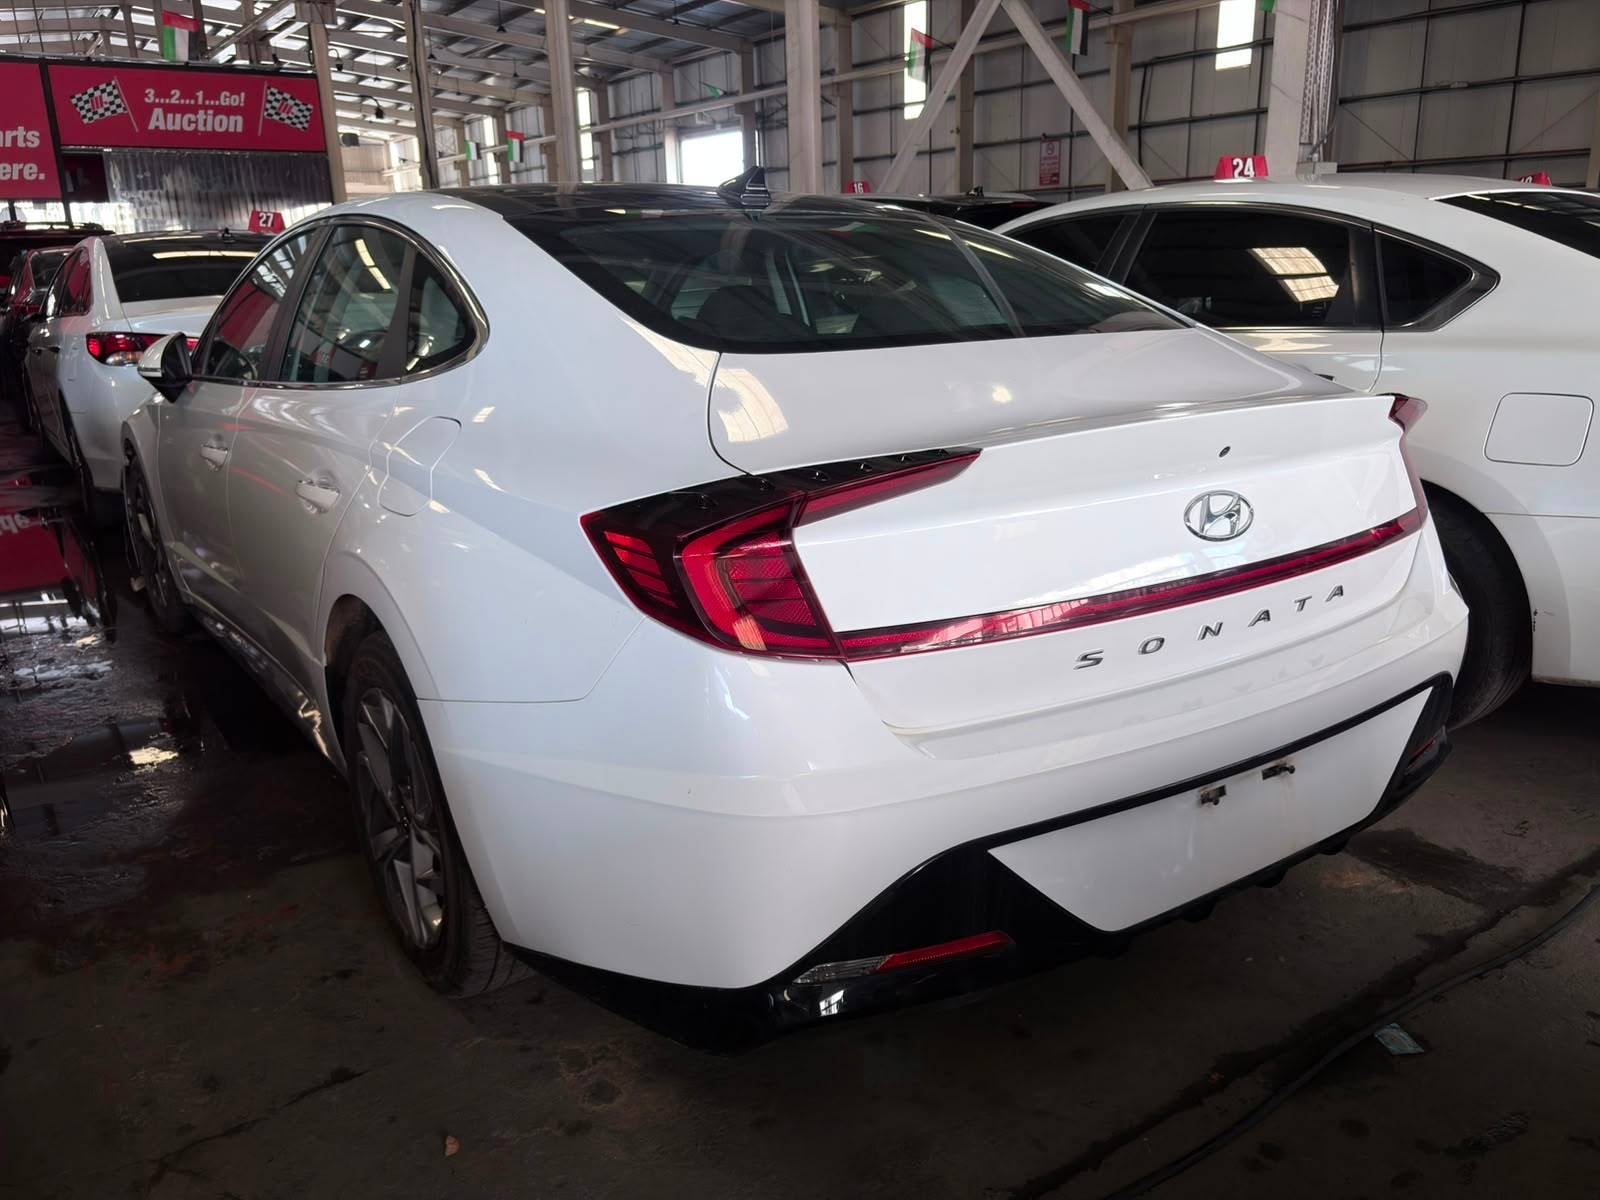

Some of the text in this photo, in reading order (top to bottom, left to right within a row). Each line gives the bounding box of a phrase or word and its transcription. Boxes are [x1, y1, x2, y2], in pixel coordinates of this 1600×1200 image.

[147, 107, 244, 133] Auction
[1232, 157, 1255, 179] 24
[259, 212, 274, 227] 27
[1073, 584, 1344, 670] SONATA
